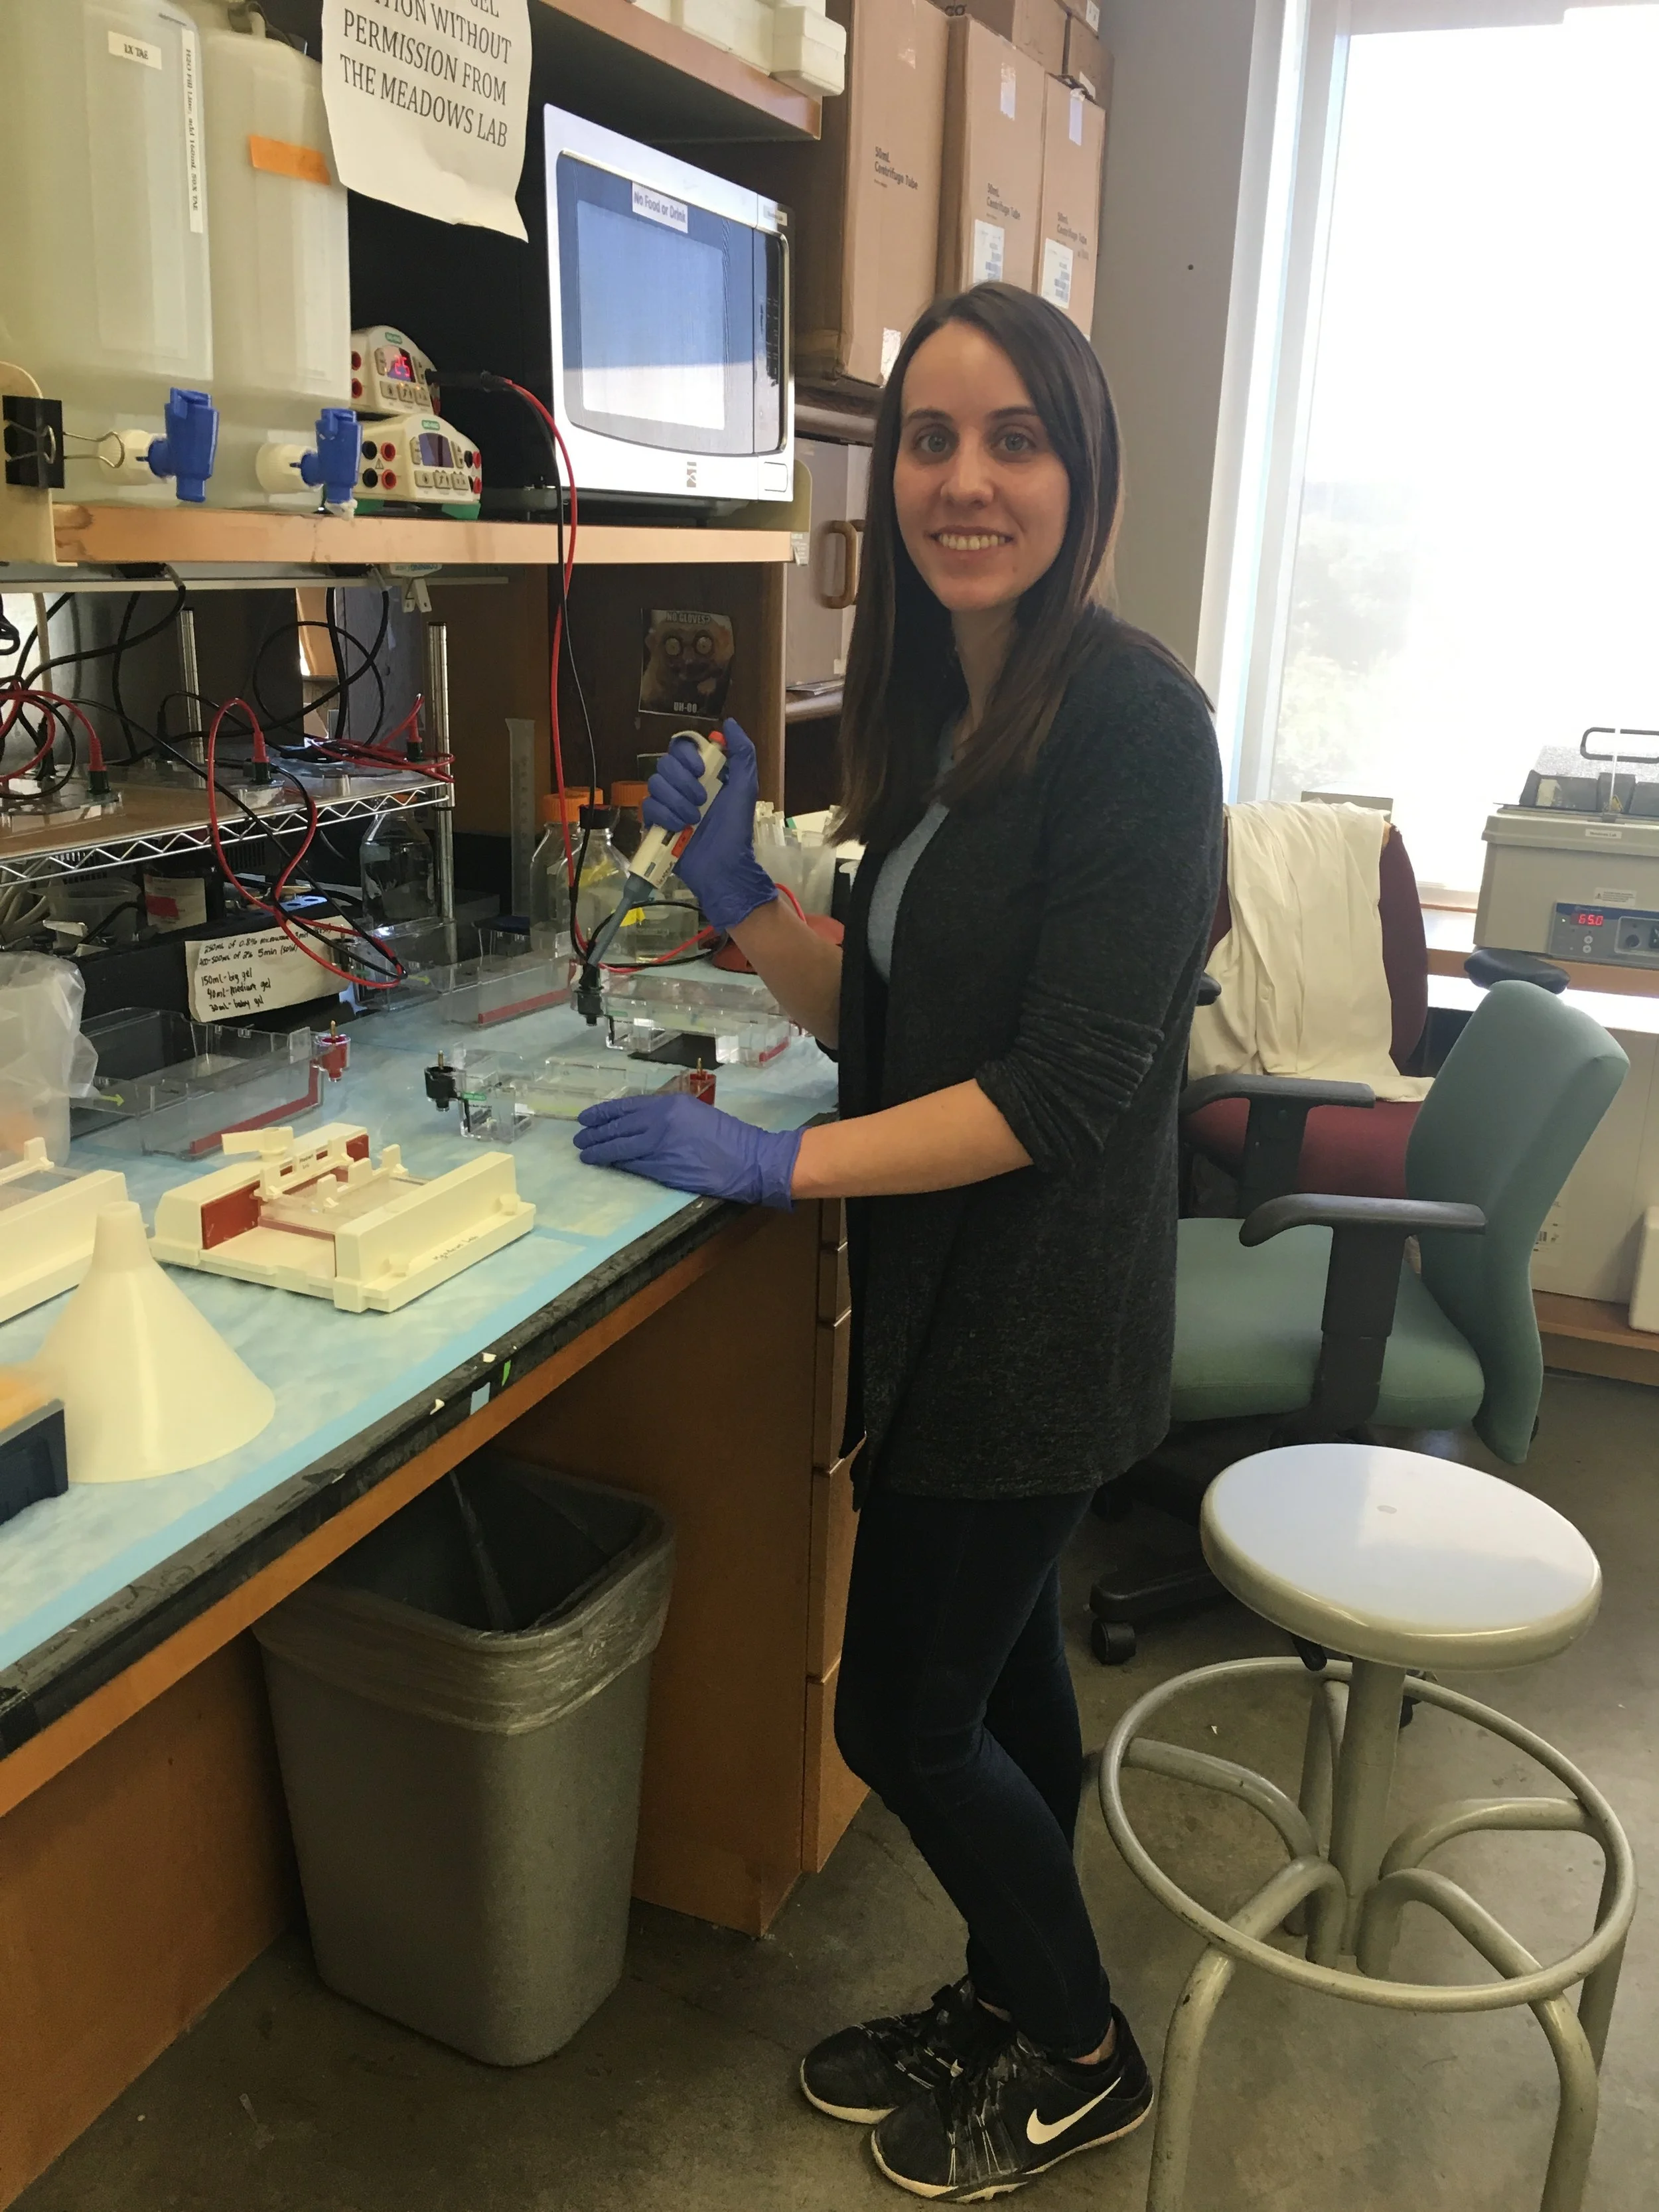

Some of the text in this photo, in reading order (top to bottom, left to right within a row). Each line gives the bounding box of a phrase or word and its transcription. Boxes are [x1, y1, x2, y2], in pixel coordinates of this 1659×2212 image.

[470, 0, 499, 18] EL
[431, 3, 512, 64] WITHOUT
[344, 8, 507, 106] PERMISSION FROM
[340, 53, 508, 148] THE MEADOWS LAB
[875, 161, 904, 185] Centrifuge
[905, 175, 918, 190] Tube
[634, 190, 686, 224] No Food or Drink
[666, 611, 710, 625] NO GLOVES?
[228, 940, 237, 949] of
[234, 951, 241, 960] of
[242, 967, 252, 982] gel
[260, 978, 271, 992] gel
[254, 994, 264, 1007] gel
